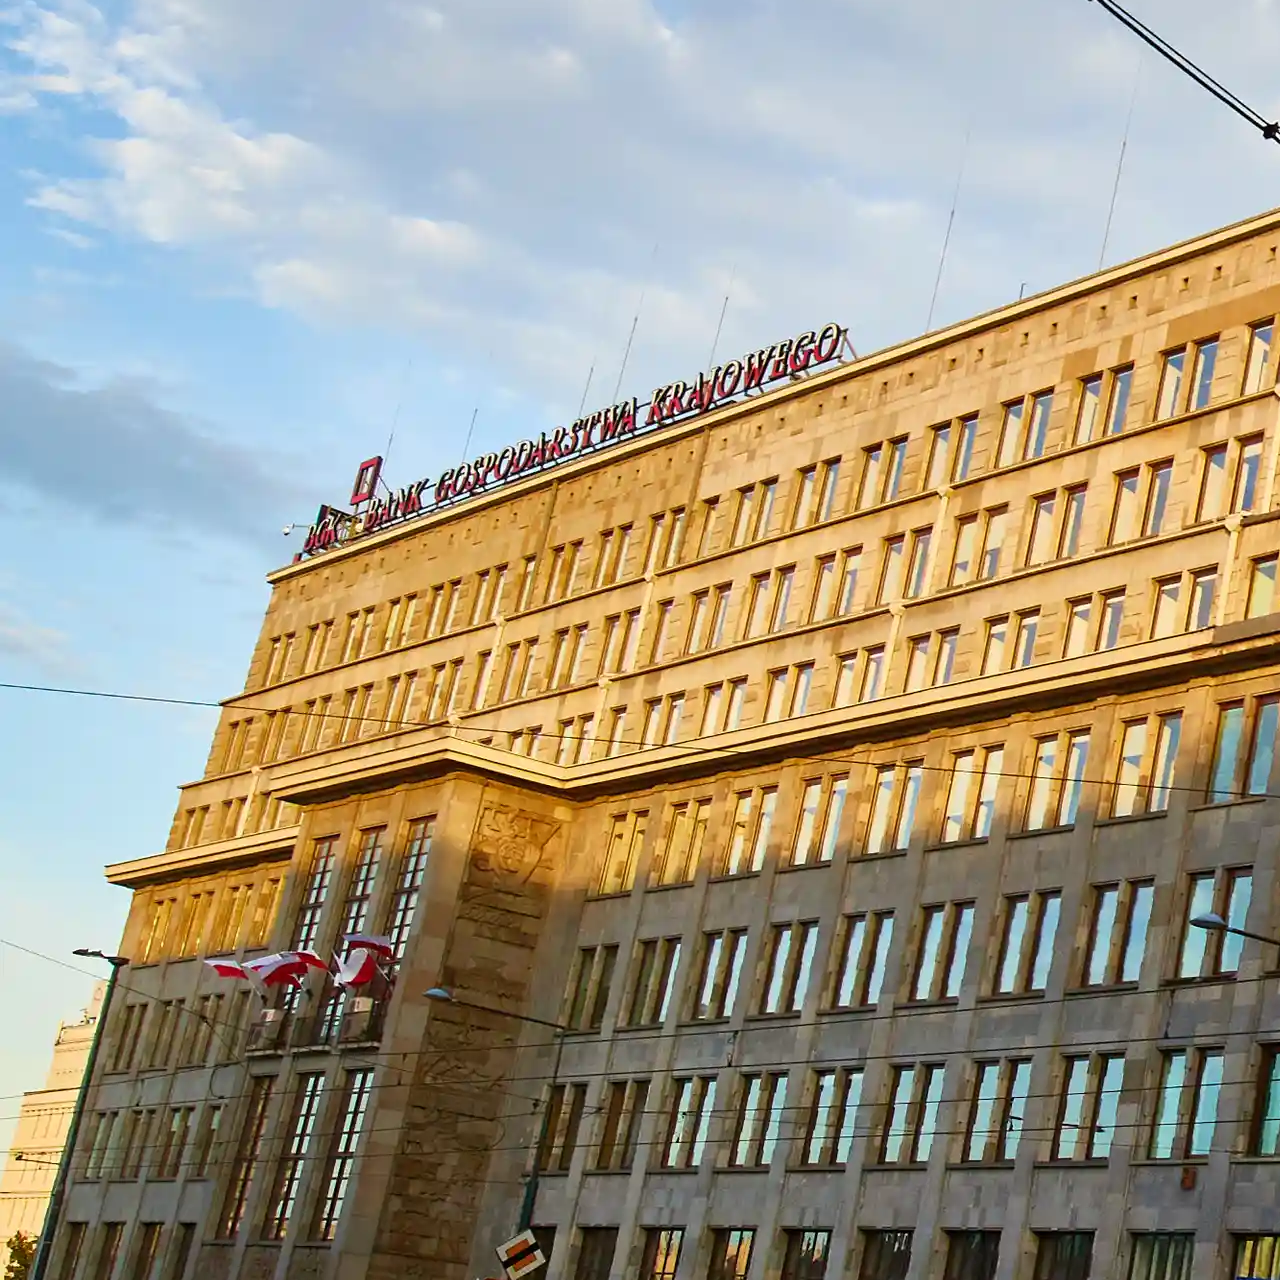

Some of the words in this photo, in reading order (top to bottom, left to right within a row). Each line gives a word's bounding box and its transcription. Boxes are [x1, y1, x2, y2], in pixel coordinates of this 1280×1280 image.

[303, 513, 341, 553] BGK
[364, 477, 429, 531] BANK
[434, 396, 638, 503] GOSPODARSTWA
[645, 322, 840, 425] KRAJOWEGO
